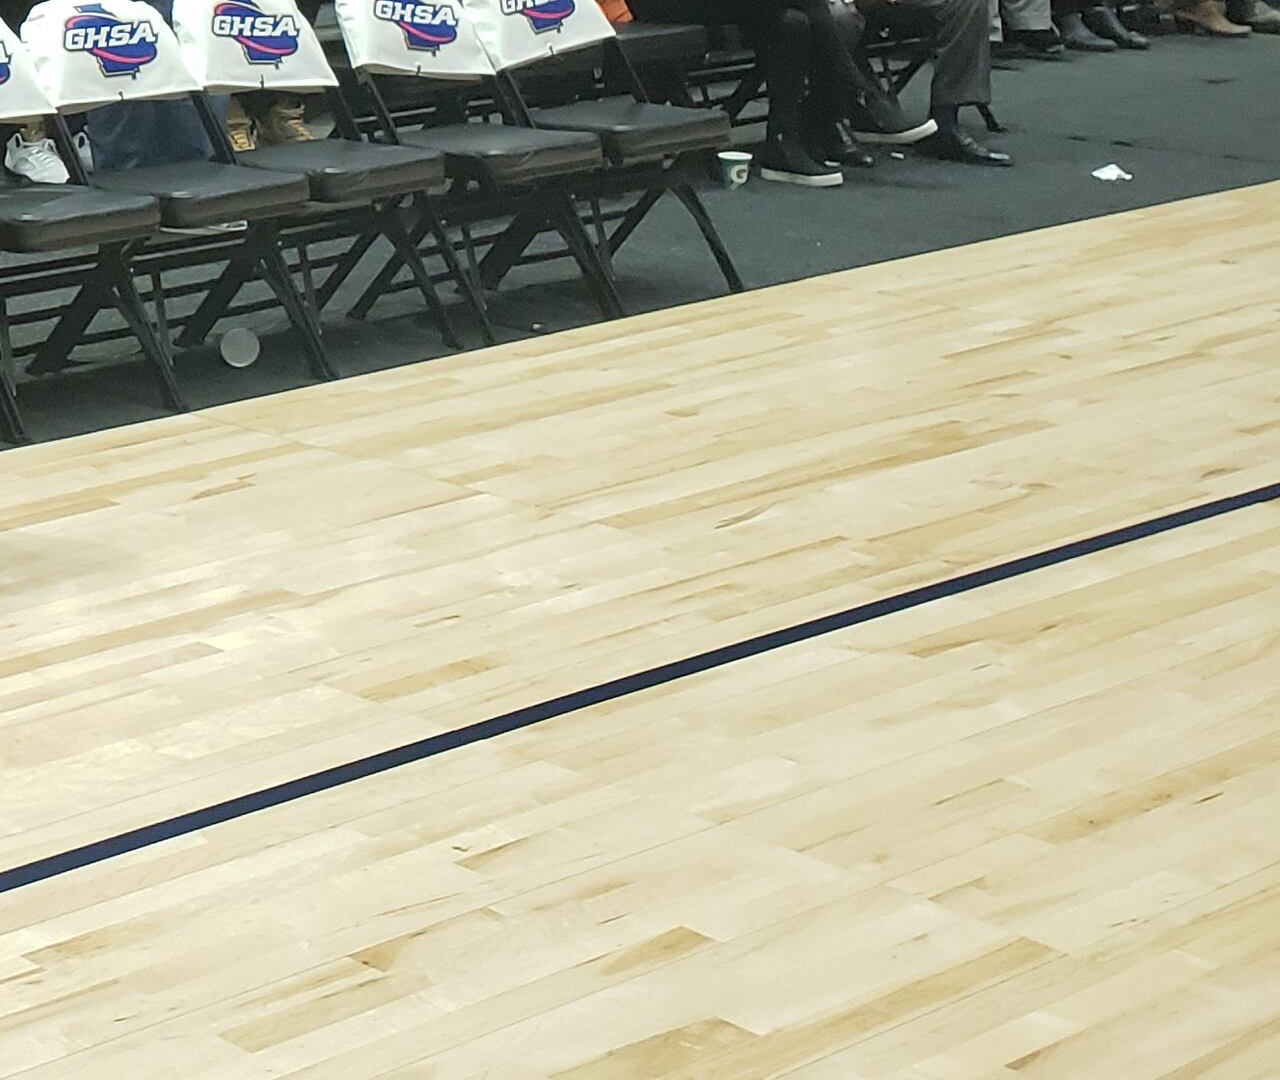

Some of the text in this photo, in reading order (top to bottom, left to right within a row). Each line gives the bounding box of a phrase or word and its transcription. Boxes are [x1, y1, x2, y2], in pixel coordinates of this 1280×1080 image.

[213, 14, 300, 38] GHSA
[374, 0, 457, 26] GHSA
[64, 21, 158, 51] GHSA
